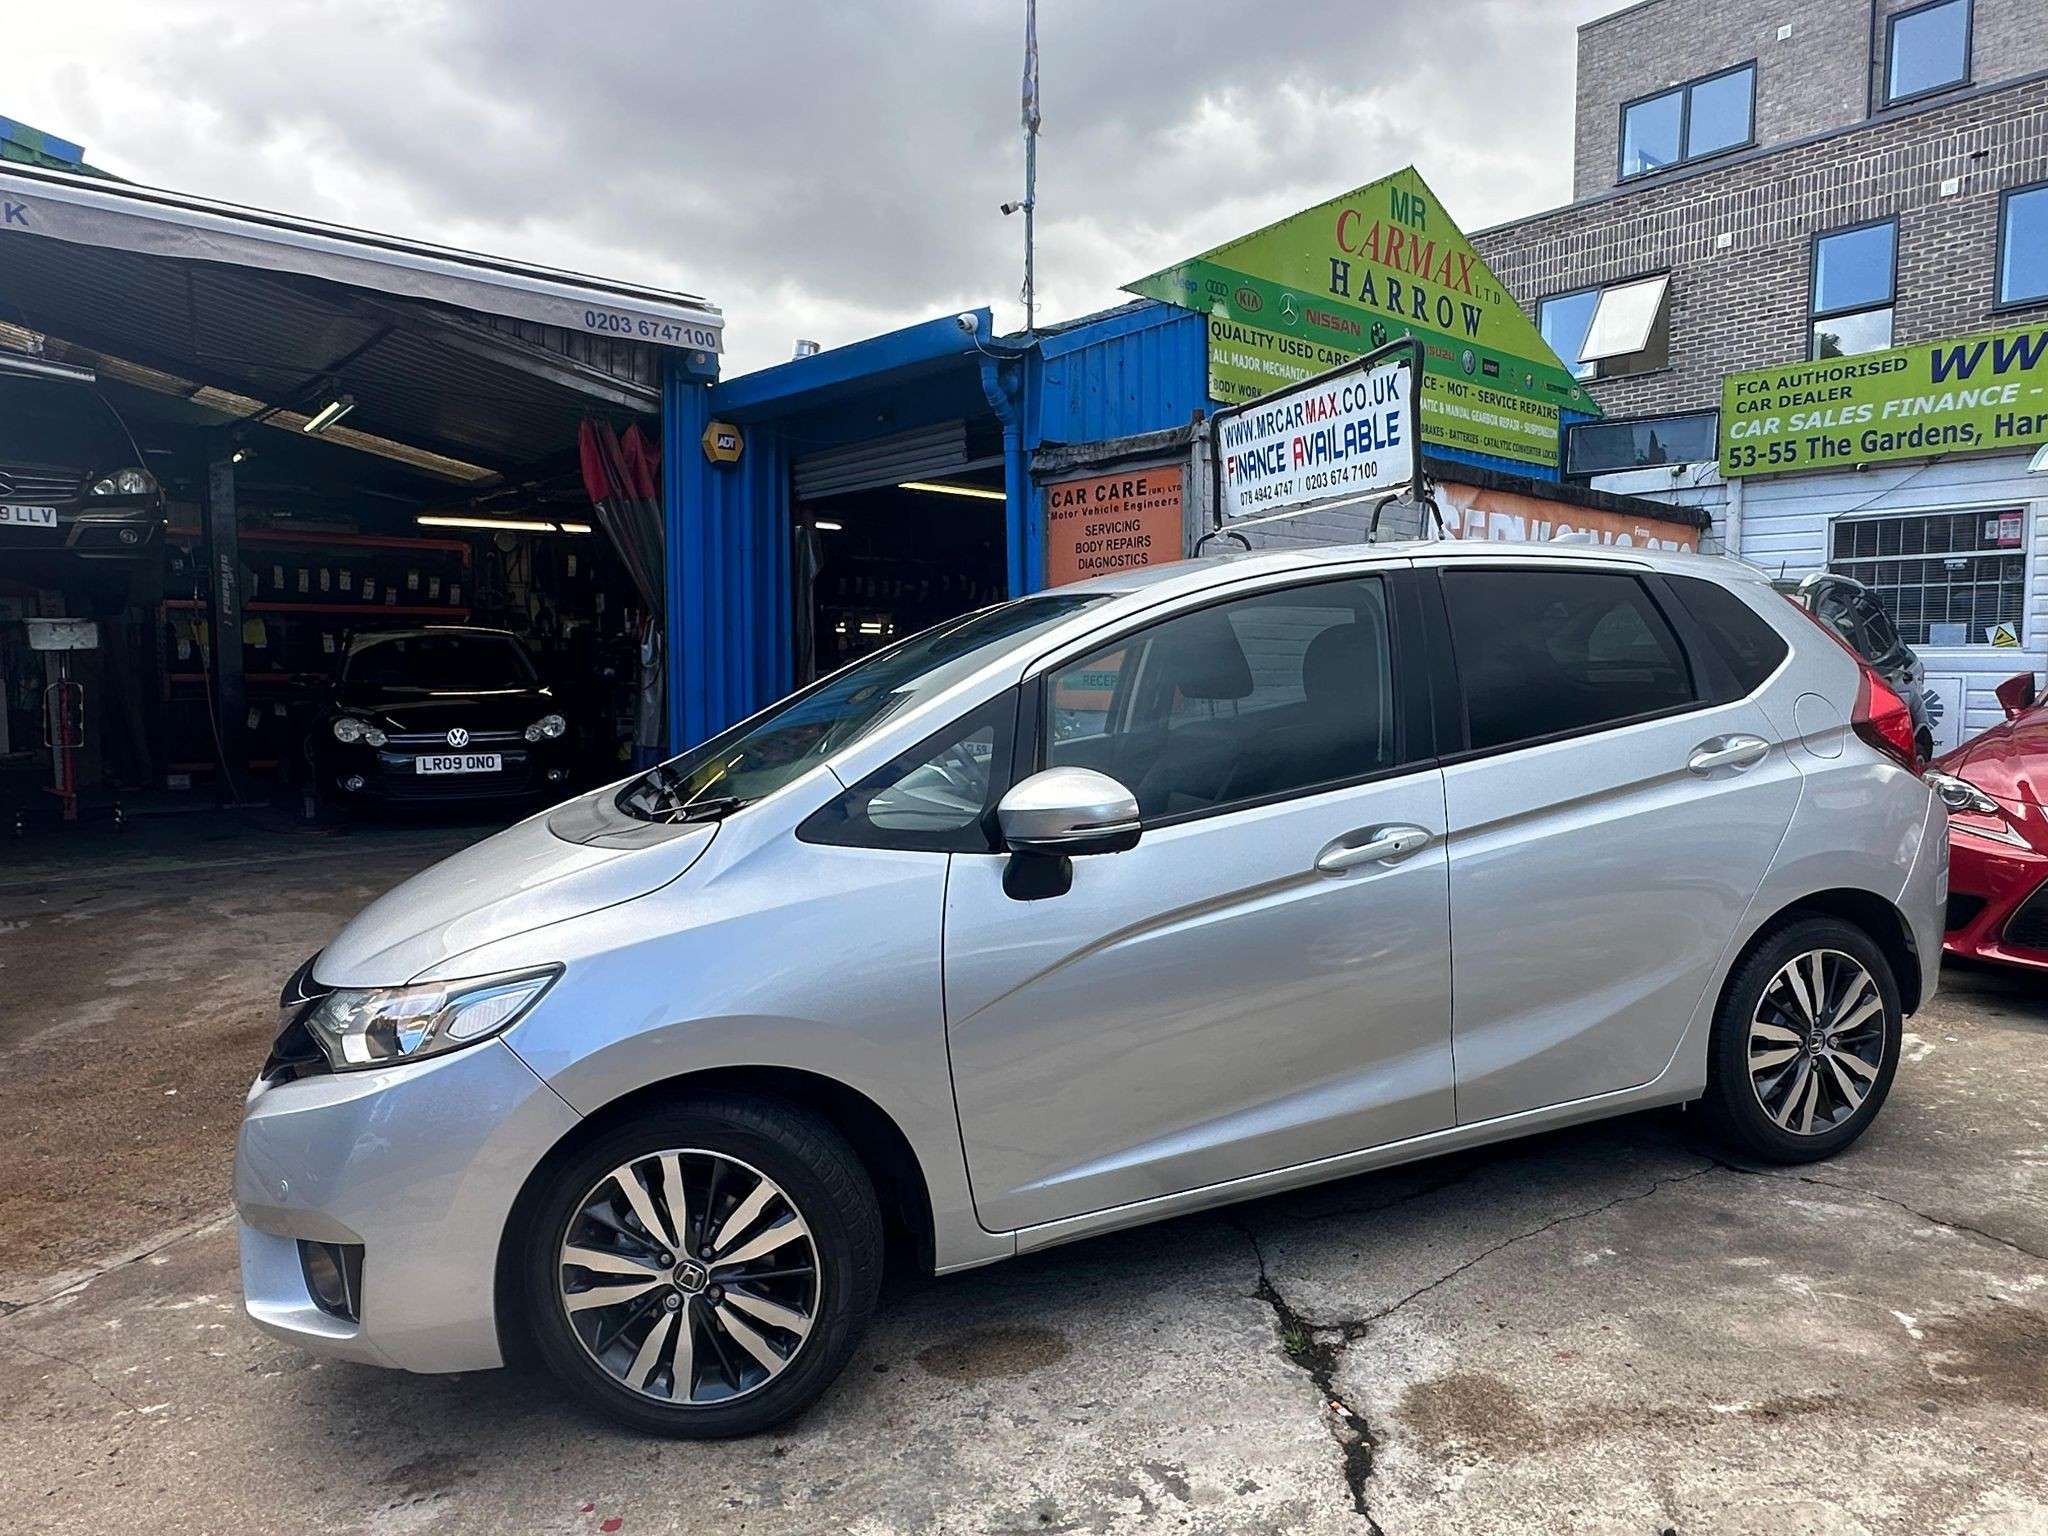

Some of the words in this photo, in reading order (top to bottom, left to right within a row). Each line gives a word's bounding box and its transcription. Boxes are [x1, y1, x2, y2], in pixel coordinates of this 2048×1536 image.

[1391, 186, 1426, 232] MR
[1336, 209, 1477, 296] CARMAX
[1475, 284, 1501, 305] LTD
[1240, 292, 1258, 308] KIA
[1329, 257, 1482, 338] HARROW
[585, 311, 632, 334] 0203
[638, 320, 715, 348] 6747100
[1306, 309, 1361, 336] NISSAN
[1211, 321, 1274, 350] QUALITY
[1278, 338, 1313, 360] USED
[1317, 348, 1350, 367] CARS
[1213, 348, 1229, 365] ALL
[1231, 352, 1261, 372] MAJOR
[1213, 378, 1237, 395] BODY
[1736, 379, 1770, 396] FCA
[1776, 357, 1908, 390] AUTHORISED
[1225, 372, 1400, 449] WWW.MRCARMAX.CO.UK
[1448, 382, 1469, 399] MOT
[1478, 389, 1518, 412] SERVICE
[1520, 400, 1558, 420] REPAIRS
[1730, 416, 1781, 440] CAR
[1788, 403, 1874, 433] SALES
[1882, 383, 2021, 420] FINANCE
[1736, 398, 1772, 414] CAR
[1778, 386, 1852, 409] DEALER
[718, 436, 736, 449] ADT
[1227, 440, 1287, 488] FINANCE
[1292, 410, 1401, 473] AVAILABLE
[1728, 439, 1797, 470] 53-55
[1806, 434, 1851, 460] The
[1860, 422, 1983, 454] Gardens,
[1995, 412, 2048, 438] Har
[1051, 488, 1087, 509] CAR
[1095, 479, 1147, 502] CARE
[1274, 480, 1293, 499] 4747
[1305, 473, 1328, 491] 0203
[1330, 467, 1349, 486] 674
[1352, 461, 1378, 481] 7100
[16, 507, 53, 523] LLV
[1050, 509, 1079, 520] Motor
[1081, 504, 1119, 517] Vehicle
[1123, 497, 1179, 512] Engineers
[1085, 519, 1141, 537] SERVICING
[1075, 539, 1104, 555] BODY
[1106, 535, 1152, 552] REPAIRS
[1078, 552, 1148, 570] DIAGNOSTICS
[422, 757, 462, 771] LR09
[466, 755, 495, 770] ONO
